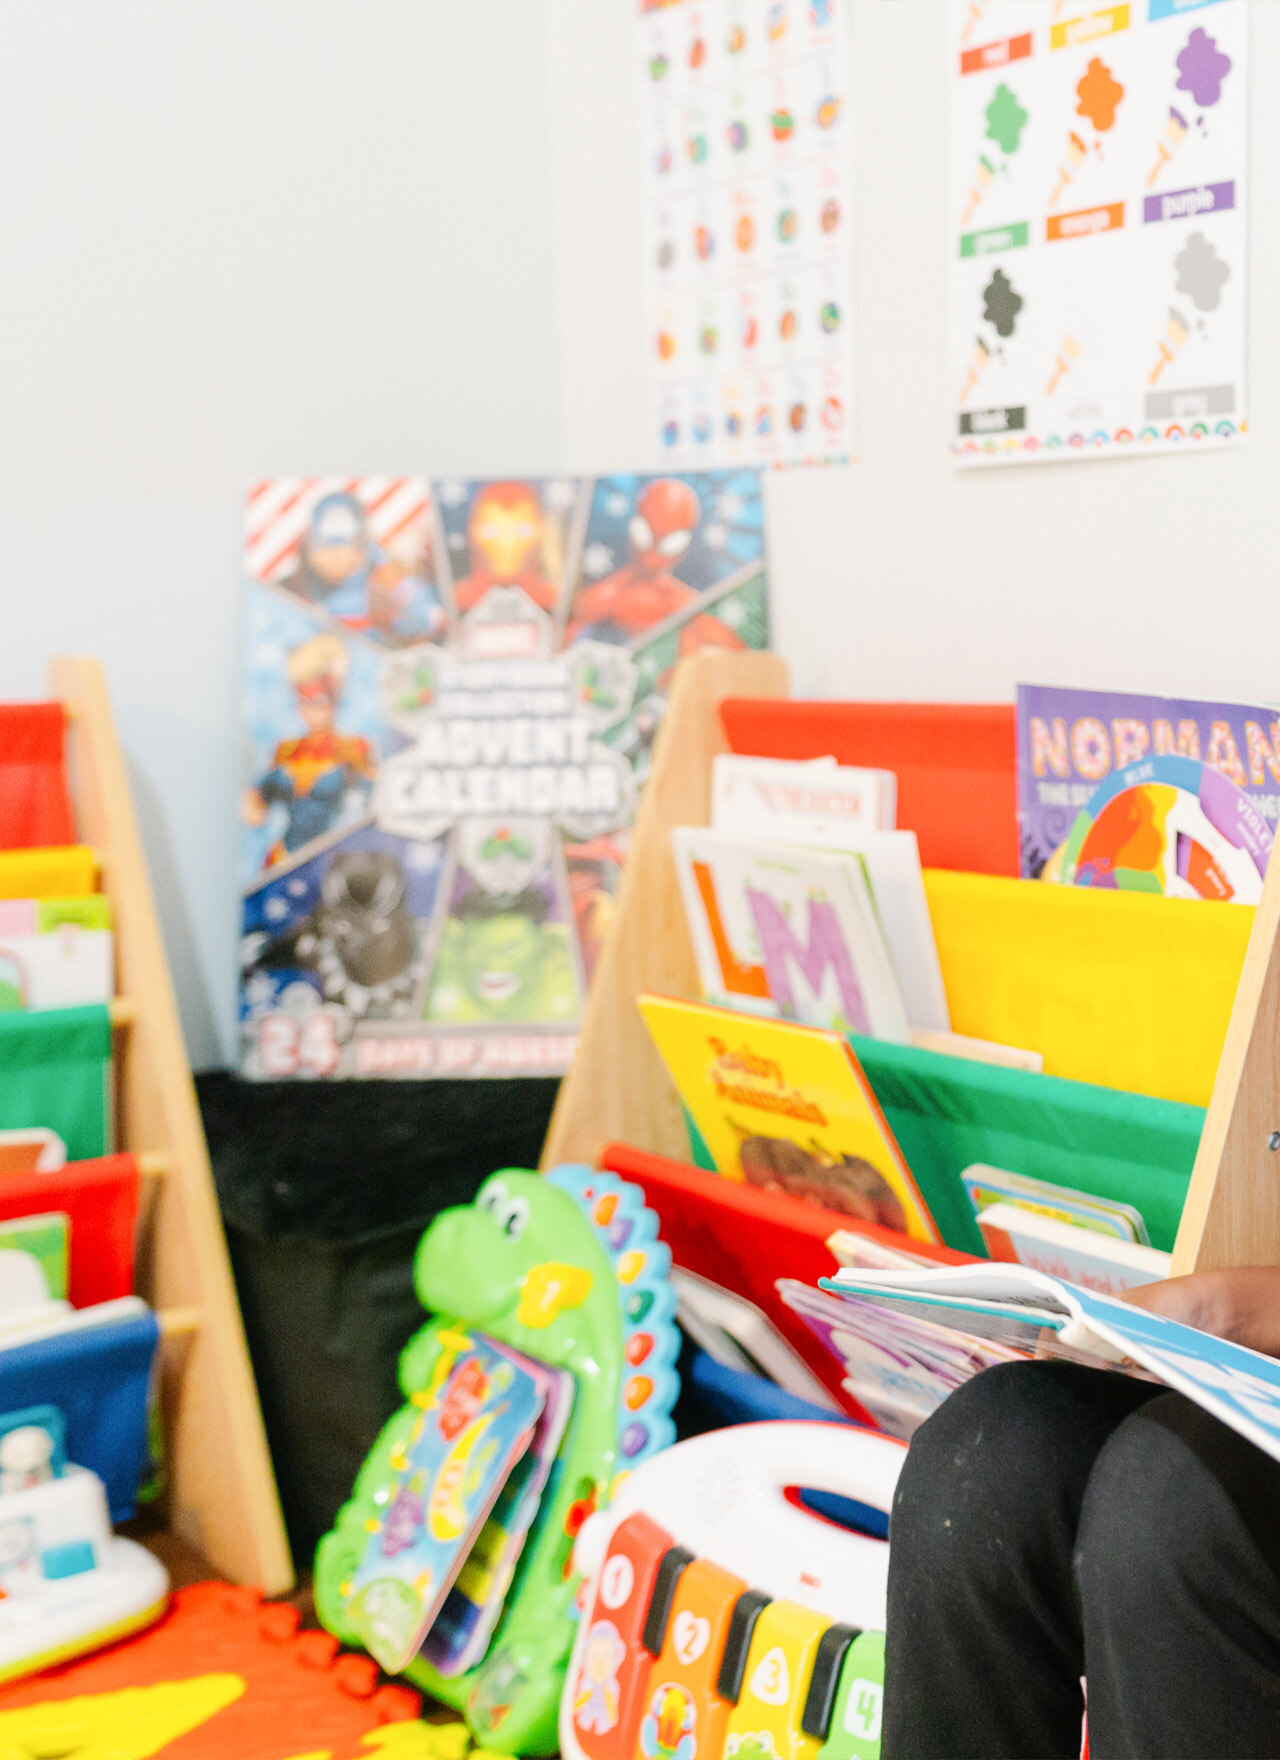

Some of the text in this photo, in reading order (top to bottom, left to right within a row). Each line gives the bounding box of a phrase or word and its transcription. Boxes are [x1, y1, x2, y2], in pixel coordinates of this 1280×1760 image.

[422, 718, 590, 766] ADVENT
[388, 765, 620, 814] CALENDAR
[680, 1623, 698, 1657] 2
[763, 1658, 782, 1694] 3
[857, 1689, 879, 1731] 4
